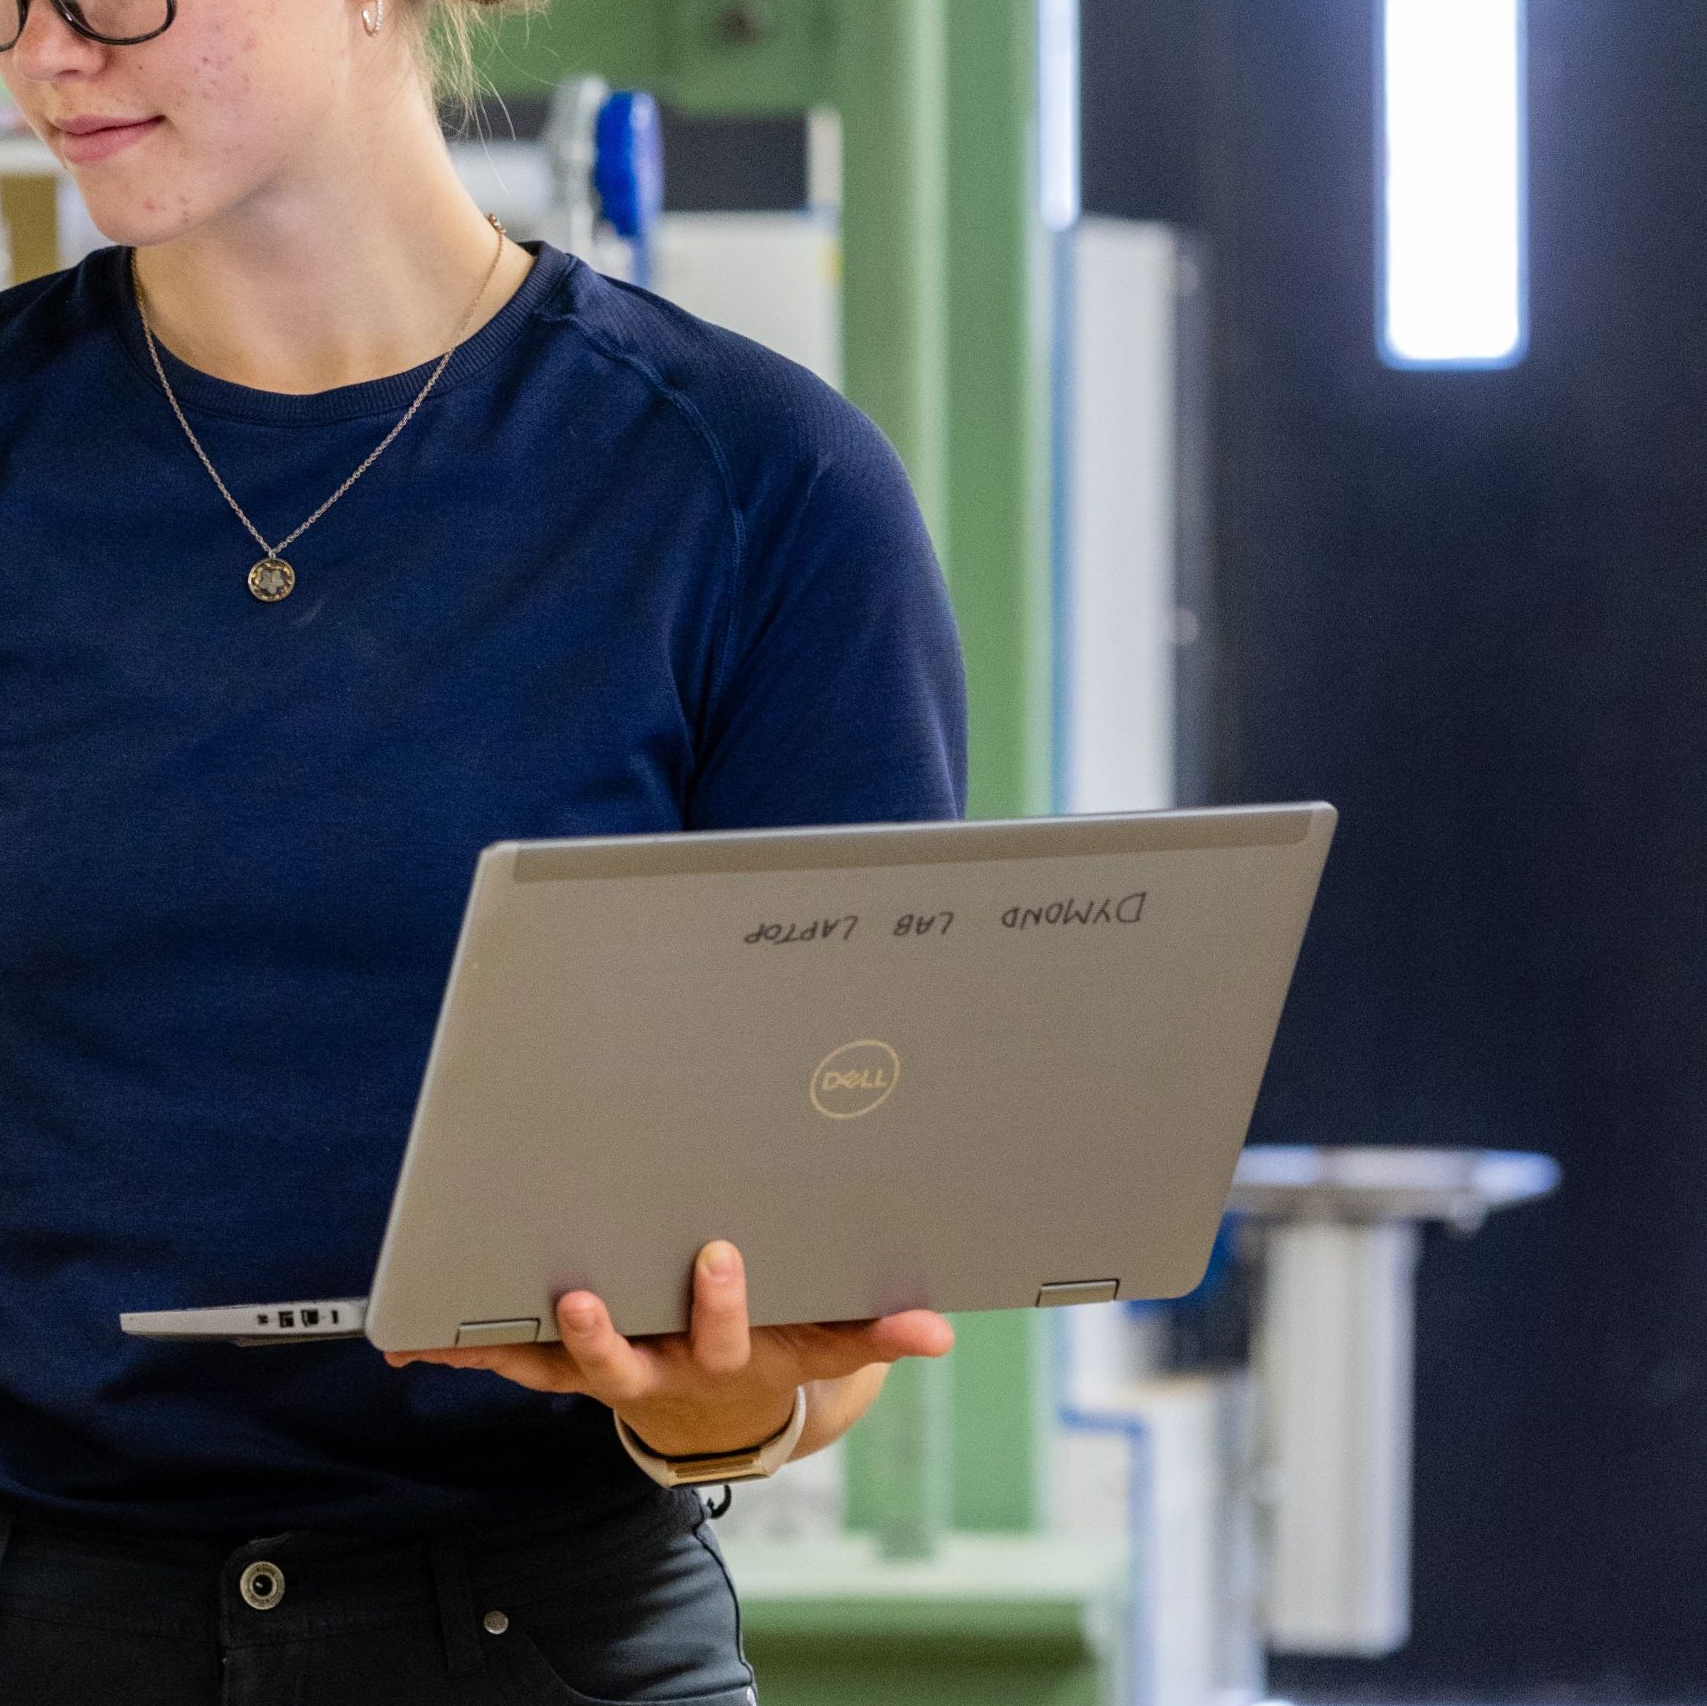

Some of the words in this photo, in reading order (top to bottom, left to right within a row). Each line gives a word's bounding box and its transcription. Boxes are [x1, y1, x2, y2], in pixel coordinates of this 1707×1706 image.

[893, 910, 955, 937] LAB
[1001, 891, 1148, 931] DYMOND
[743, 914, 859, 946] LAPTOP
[821, 1068, 886, 1091] DELL
